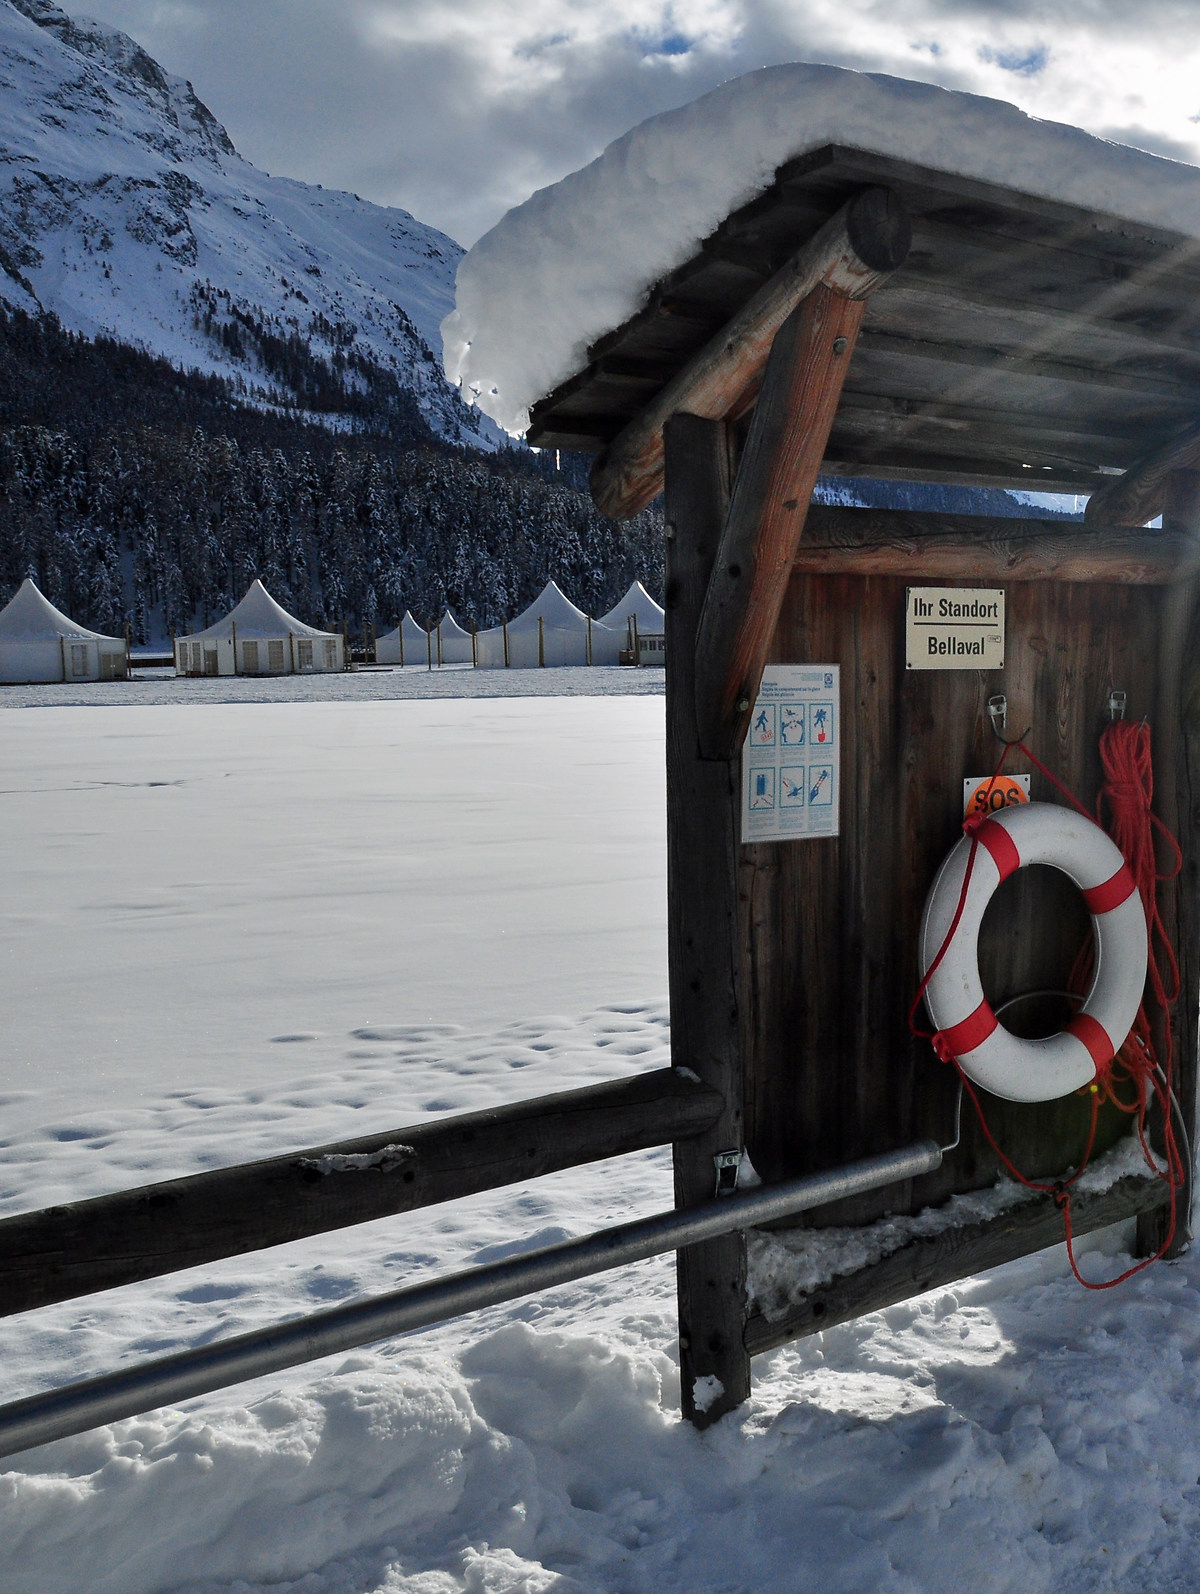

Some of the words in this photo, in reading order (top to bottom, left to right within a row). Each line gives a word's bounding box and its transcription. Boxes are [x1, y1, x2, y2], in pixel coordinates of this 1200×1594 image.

[914, 598, 934, 616] Ihr
[939, 598, 998, 618] Standort
[928, 636, 985, 655] Bellaval
[975, 788, 1020, 812] SOS
